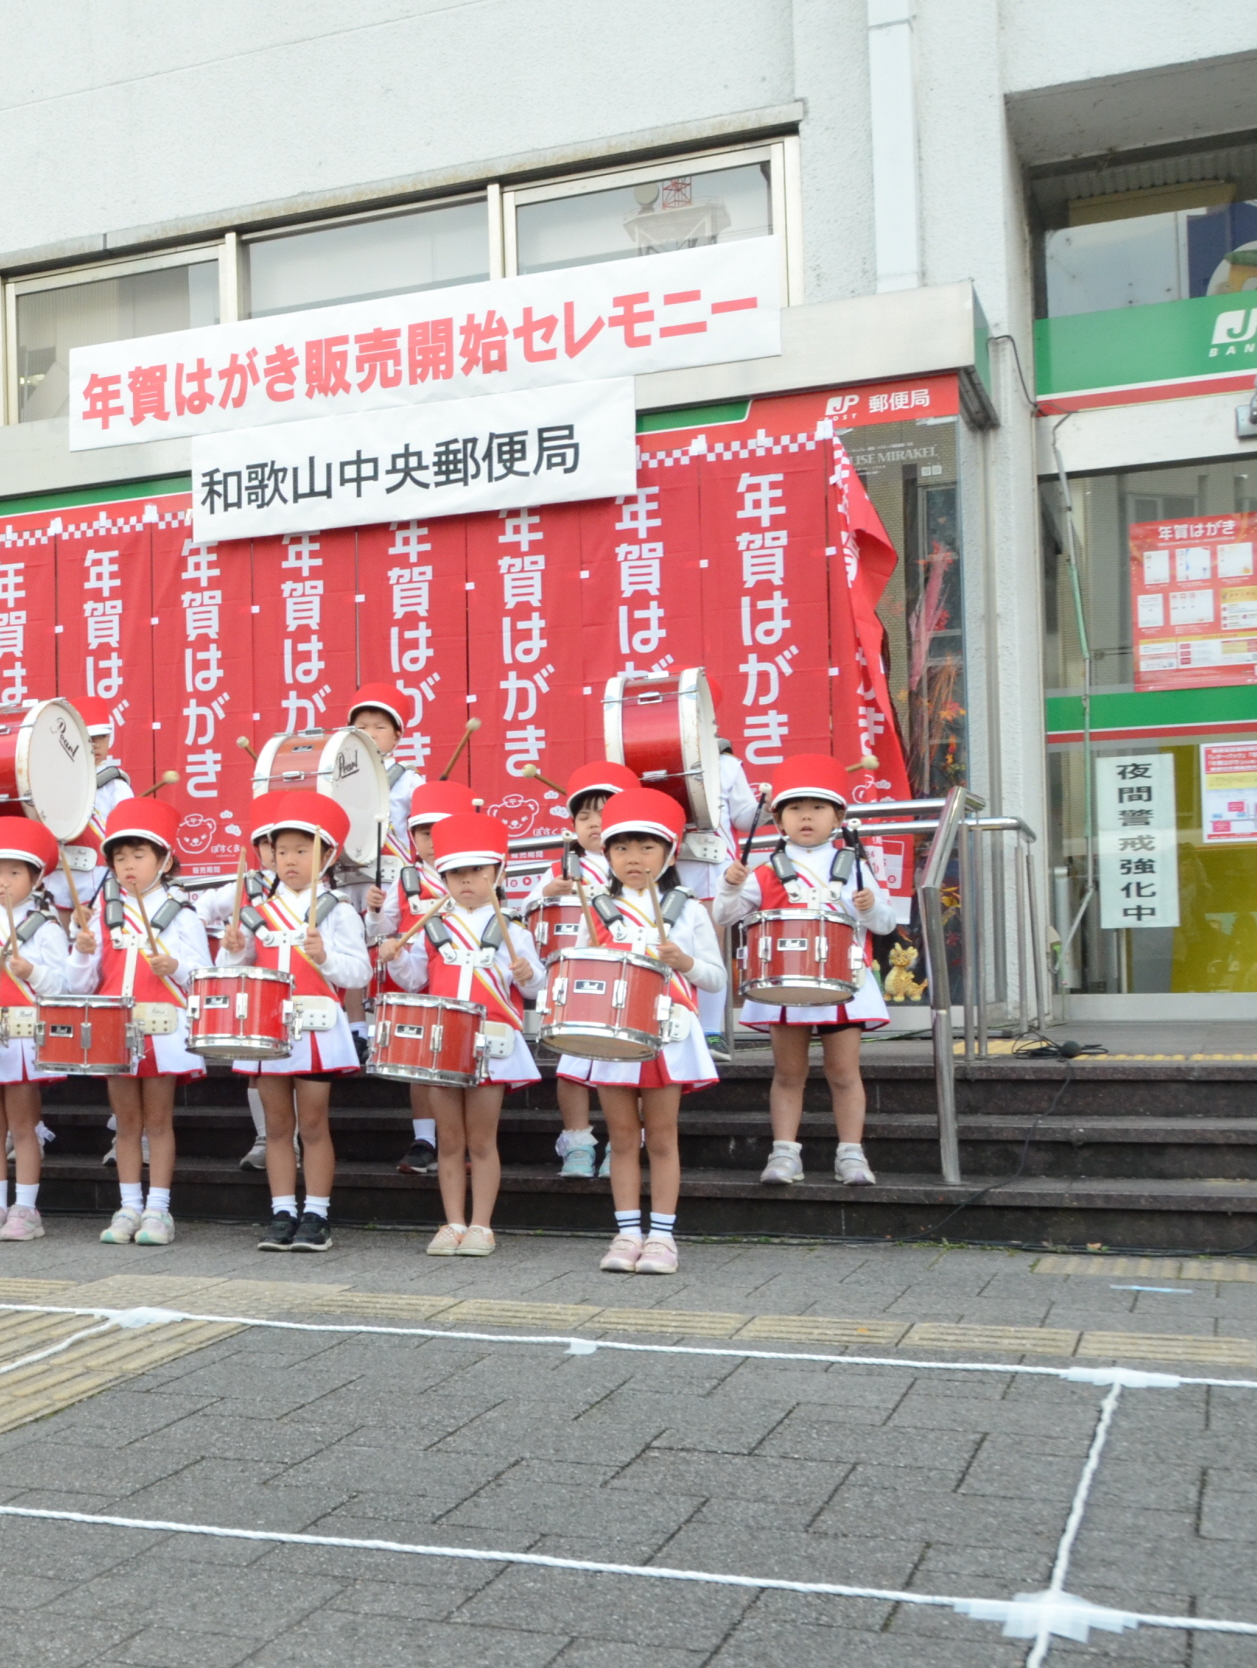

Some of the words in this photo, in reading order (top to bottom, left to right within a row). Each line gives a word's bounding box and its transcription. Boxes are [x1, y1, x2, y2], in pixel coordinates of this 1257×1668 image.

[82, 289, 758, 430] 年賀はがき販売開始セレモニー
[869, 388, 930, 413] 郵便局
[201, 424, 580, 514] 和歌山中央郵便局
[1158, 520, 1236, 540] 年賀はがき
[181, 538, 230, 798] 年賀はがき
[498, 508, 554, 776] 年賀はがき
[736, 472, 799, 764] 年賀はがき
[336, 750, 359, 780] Pearl
[1117, 763, 1157, 921] 夜間警戒強化中
